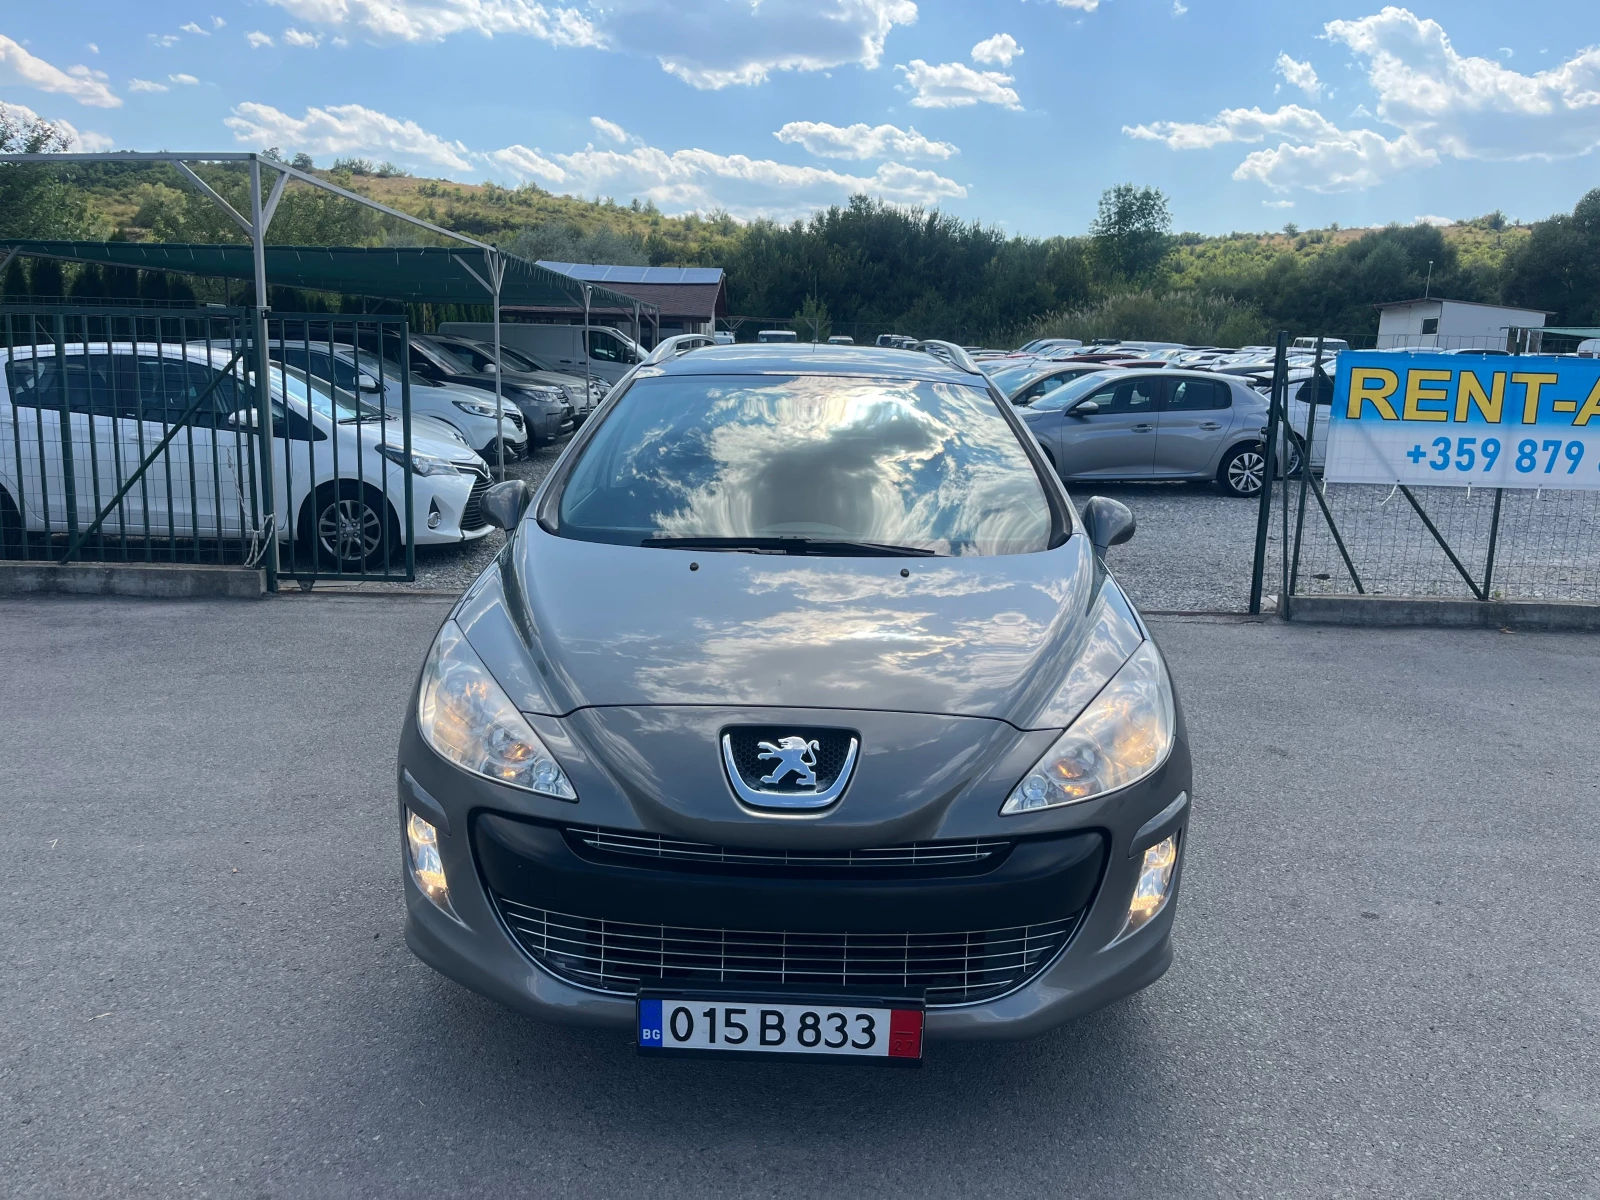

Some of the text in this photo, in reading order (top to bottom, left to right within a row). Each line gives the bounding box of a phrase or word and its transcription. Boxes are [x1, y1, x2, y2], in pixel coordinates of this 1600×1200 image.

[1406, 436, 1501, 473] +359
[1514, 438, 1585, 474] 879
[642, 1028, 661, 1041] BG
